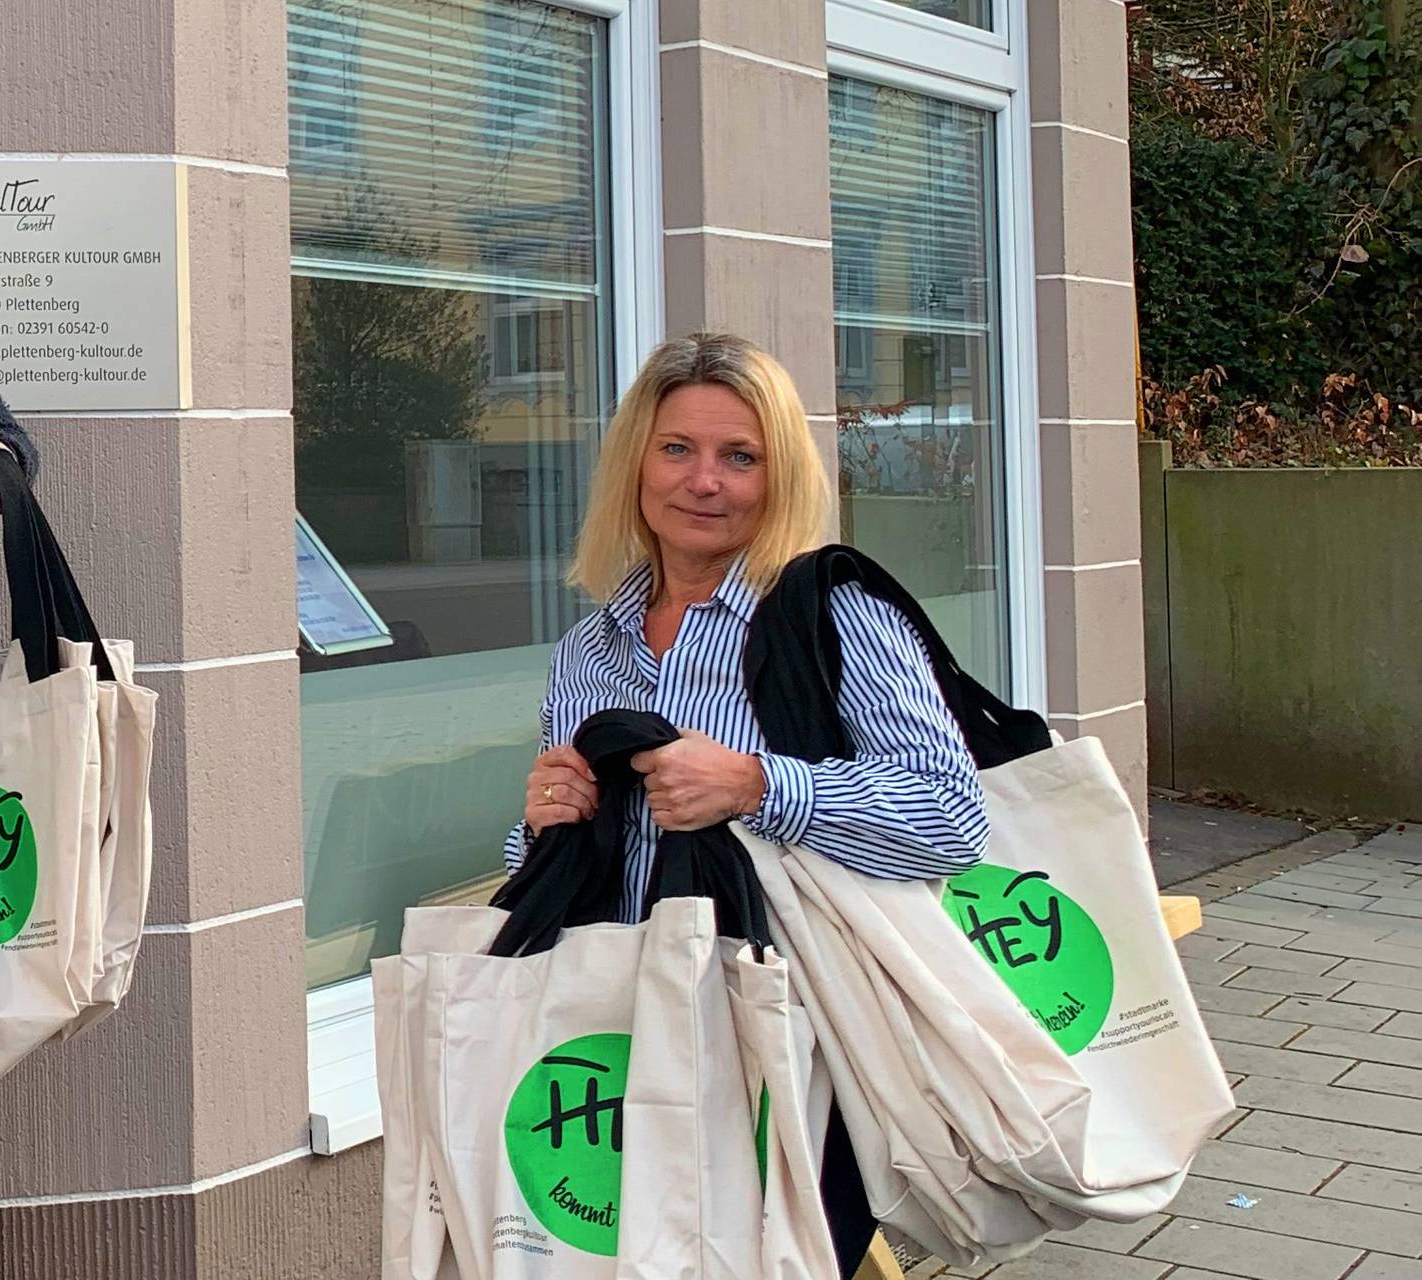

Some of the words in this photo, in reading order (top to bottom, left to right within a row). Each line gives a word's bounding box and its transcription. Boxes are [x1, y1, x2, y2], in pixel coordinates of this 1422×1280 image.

[17, 214, 55, 232] GmbH
[64, 251, 119, 264] KULTOUR
[123, 251, 161, 264] GMBH
[45, 275, 53, 288] 9
[6, 297, 80, 314] Plettenberg
[18, 322, 53, 335] 02391
[58, 321, 109, 335] 60542-0
[1119, 999, 1169, 1020] #stadtmarke
[1101, 1010, 1174, 1038] #supportyourlocals
[548, 1176, 617, 1228] kommt
